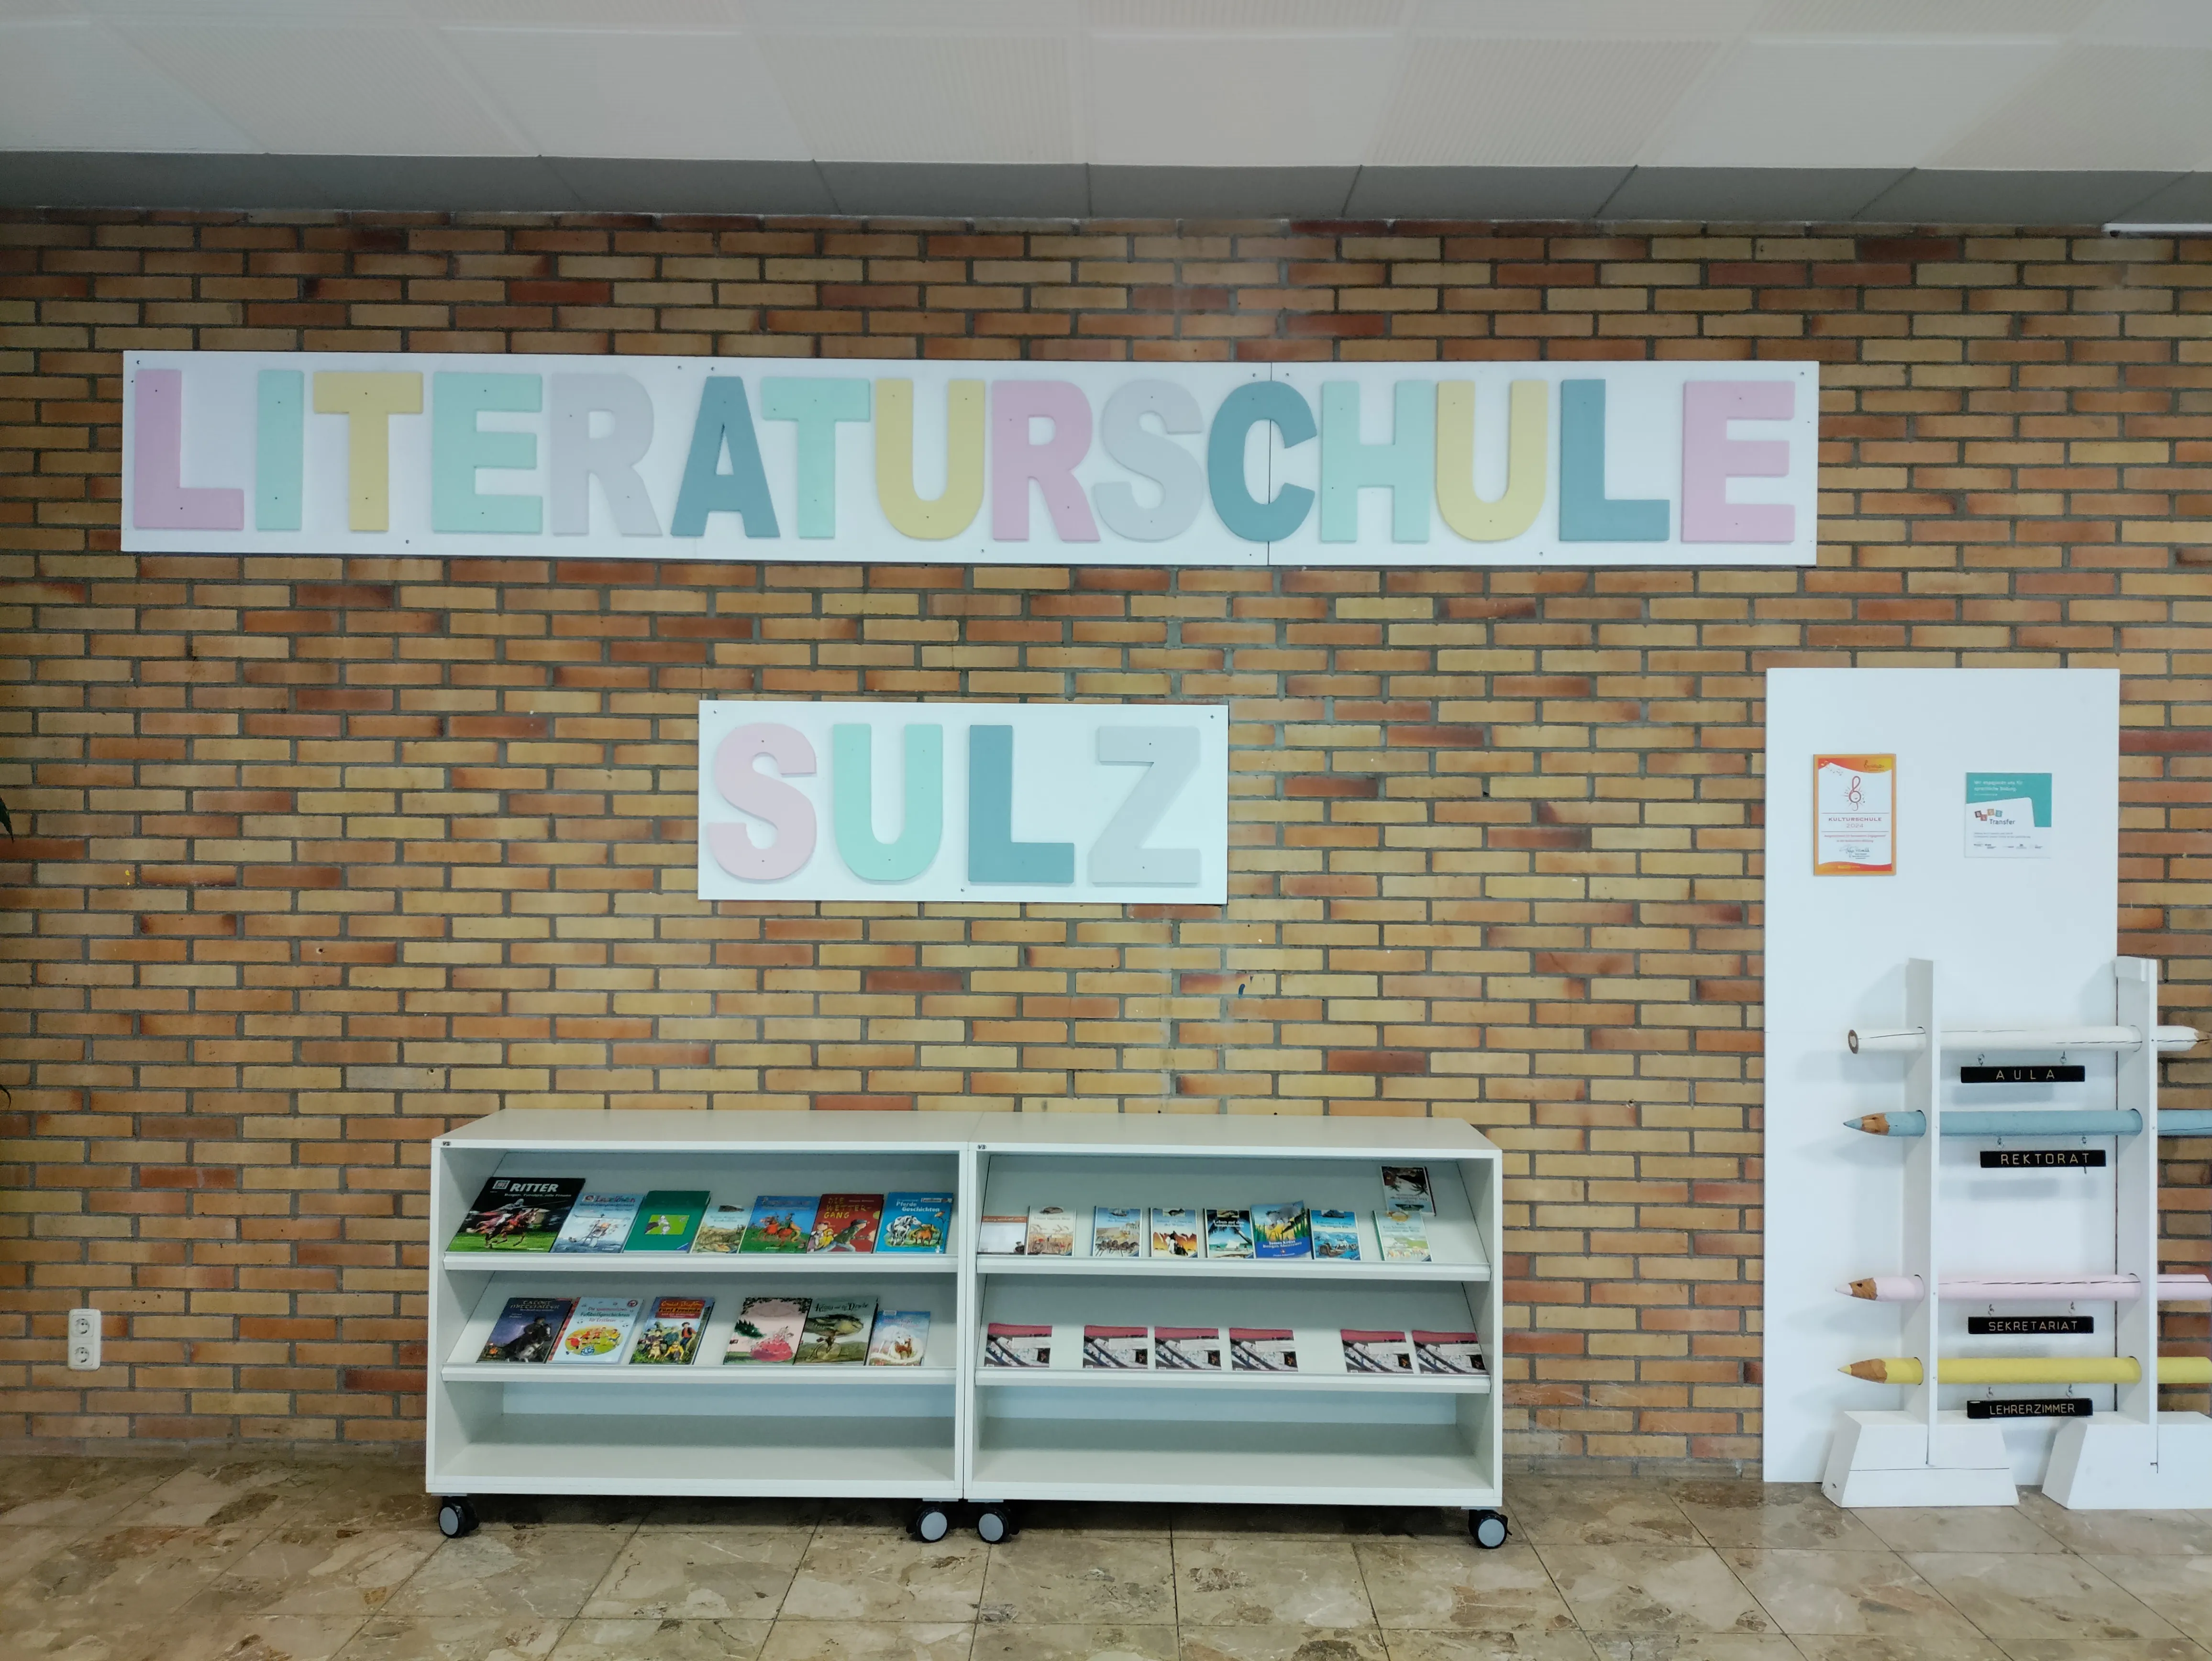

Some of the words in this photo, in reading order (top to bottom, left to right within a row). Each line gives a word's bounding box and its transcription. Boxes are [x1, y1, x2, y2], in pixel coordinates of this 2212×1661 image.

[133, 369, 1797, 544] LITERATURSCHULE
[707, 722, 1202, 885] SULZ
[1996, 1069, 2055, 1080] AULA
[2001, 1153, 2090, 1164] REKTORAT
[509, 1183, 559, 1193] RITTER
[1989, 1321, 2078, 1331] SEKRETARIAT
[1990, 1403, 2075, 1415] LEHRERZIMMER
